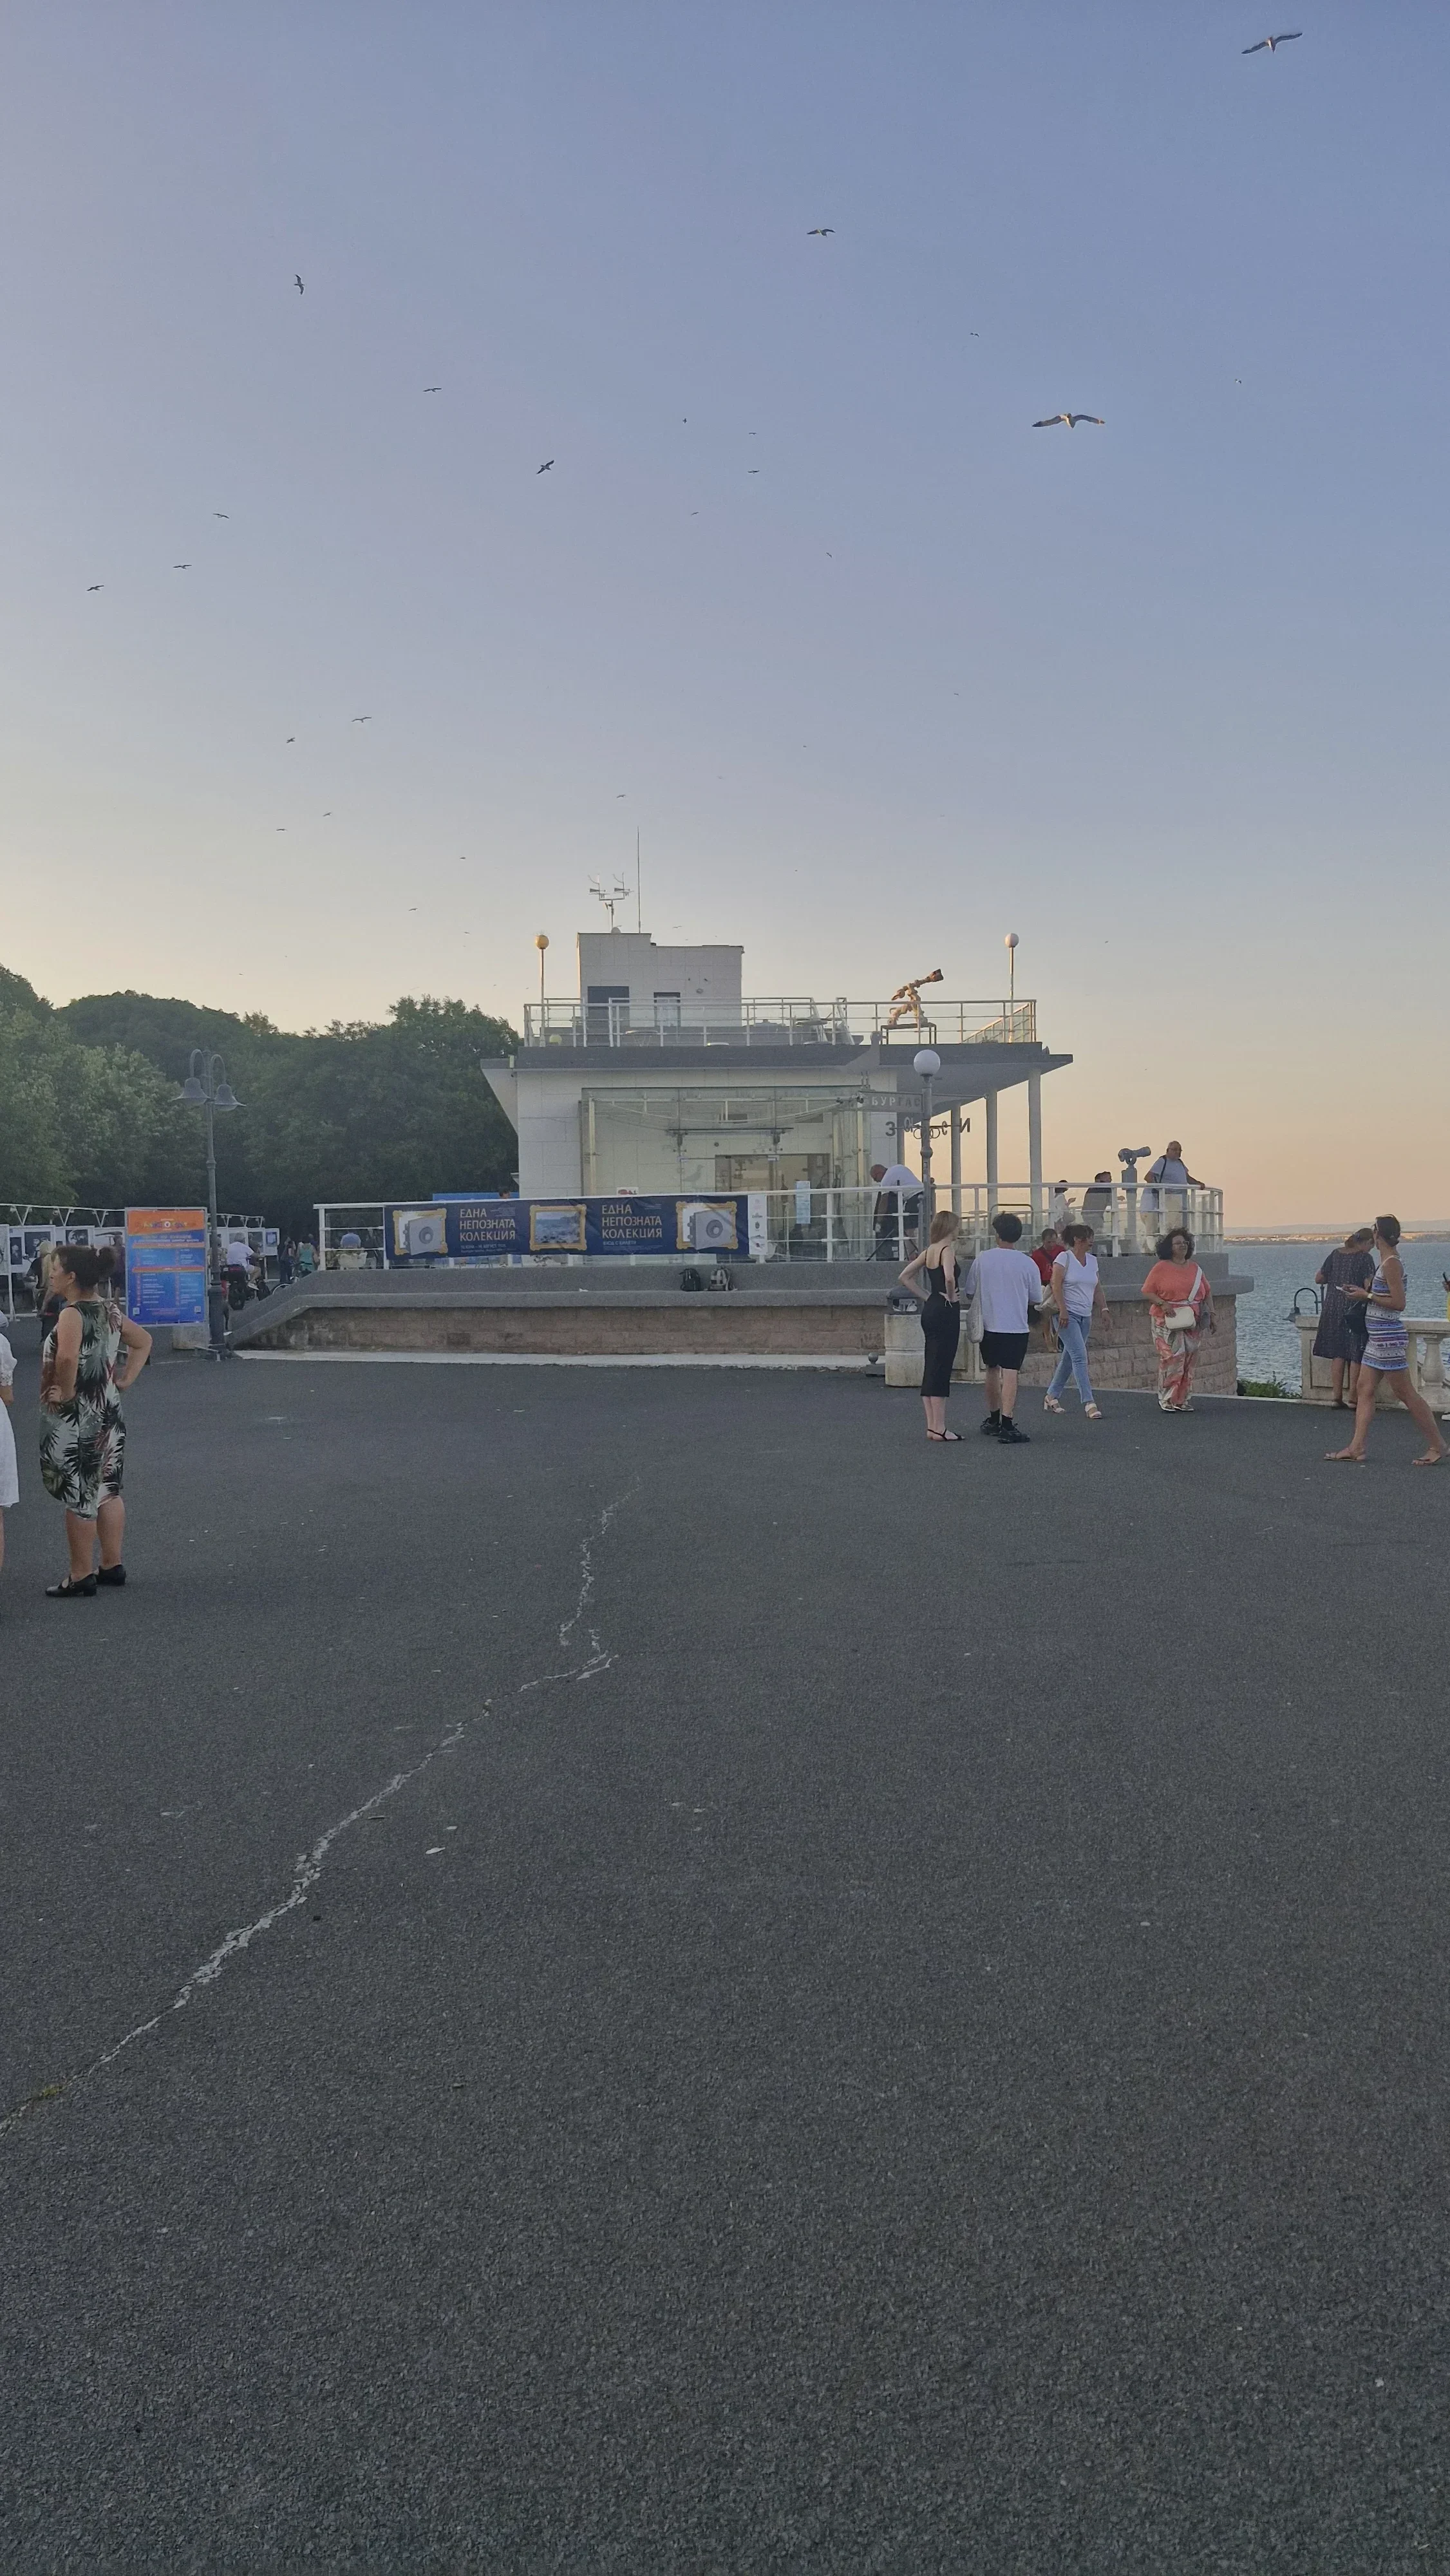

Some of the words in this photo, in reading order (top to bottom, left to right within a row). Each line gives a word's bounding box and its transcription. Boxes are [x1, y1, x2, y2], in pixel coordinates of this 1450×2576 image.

[872, 1096, 921, 1107] БУРГАС
[460, 1208, 487, 1218] ЕДНА
[602, 1204, 632, 1214] ЕДНА
[460, 1218, 516, 1230] НЕПОЗНАТА
[602, 1216, 662, 1227] НЕПОЗНАТА
[460, 1231, 516, 1242] КОЛЕКЦИЯ
[602, 1228, 662, 1238] КОЛЕКЦИЯ
